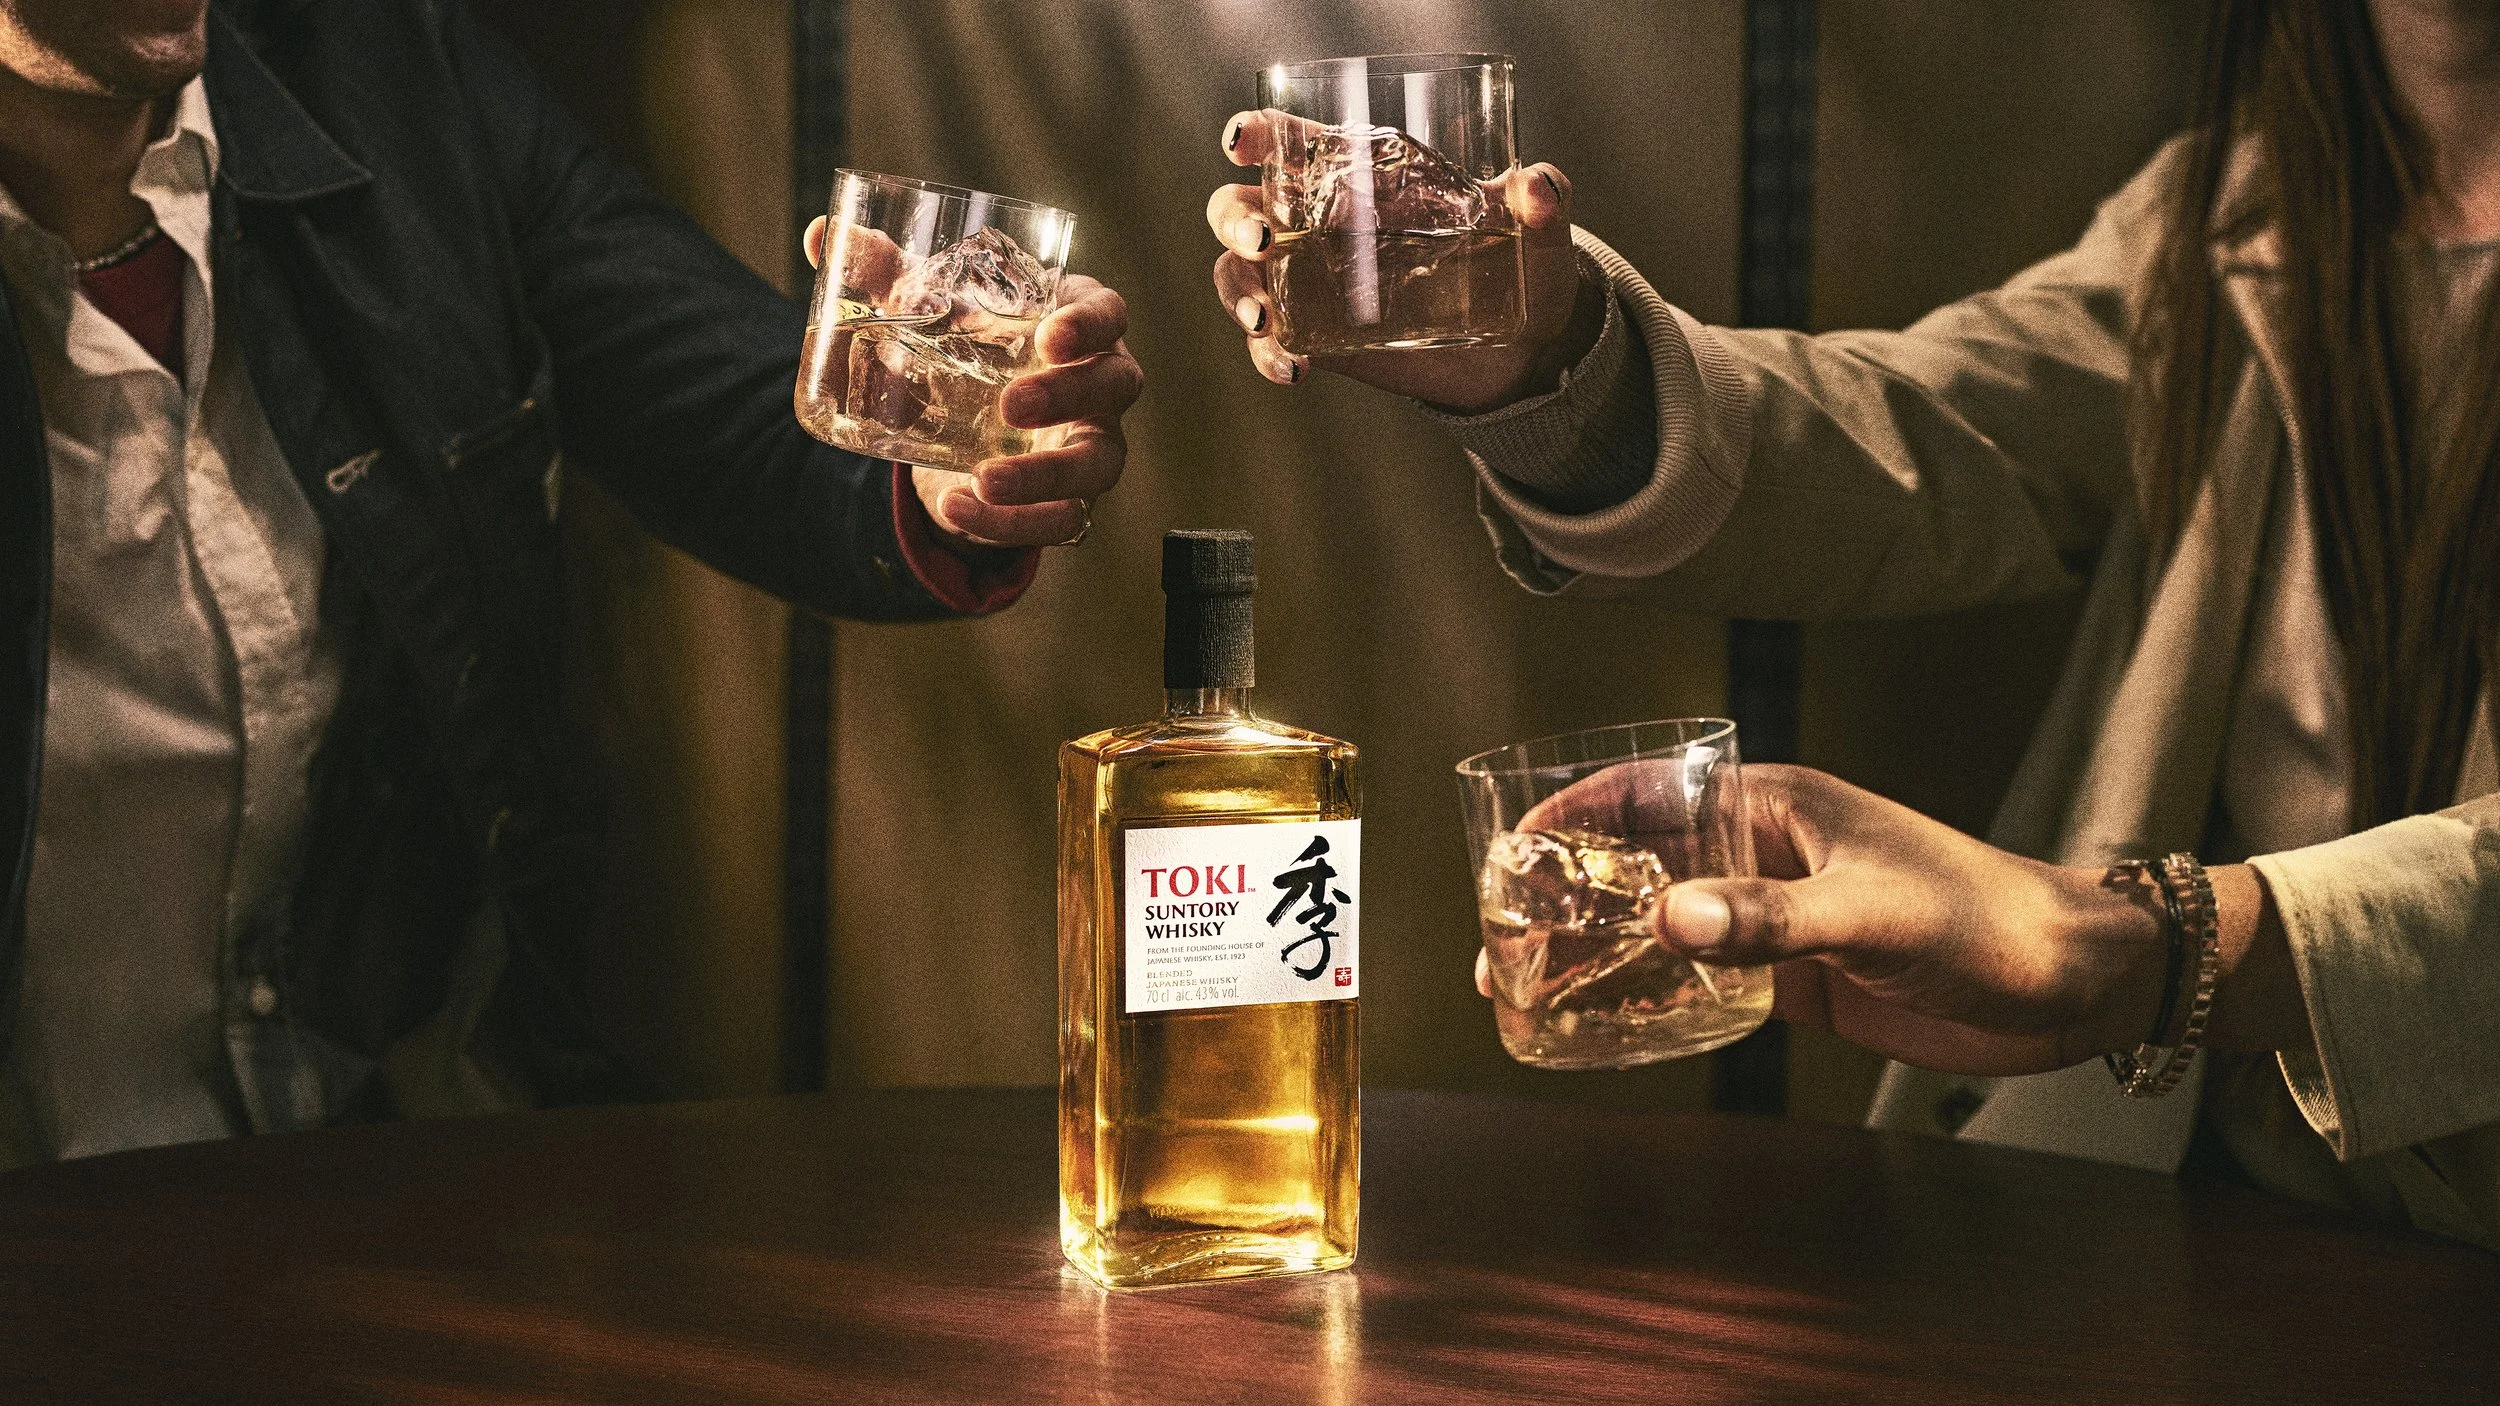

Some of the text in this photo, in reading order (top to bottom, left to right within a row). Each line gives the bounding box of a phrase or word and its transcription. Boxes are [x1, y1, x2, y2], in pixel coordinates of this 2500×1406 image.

[1141, 864, 1246, 898] TOKI
[1145, 901, 1239, 920] SUNTORY
[1266, 835, 1352, 980] 季
[1146, 921, 1225, 939] WHISKY
[1186, 944, 1226, 952] FOUNDING
[1228, 942, 1253, 950] HOUSE
[1147, 957, 1182, 965] JAPANESE
[1146, 976, 1239, 989] JAPANESE WHISKY
[1147, 969, 1193, 979] BLENDED
[1147, 985, 1240, 1003] 70 cl alc. 43% vol.
